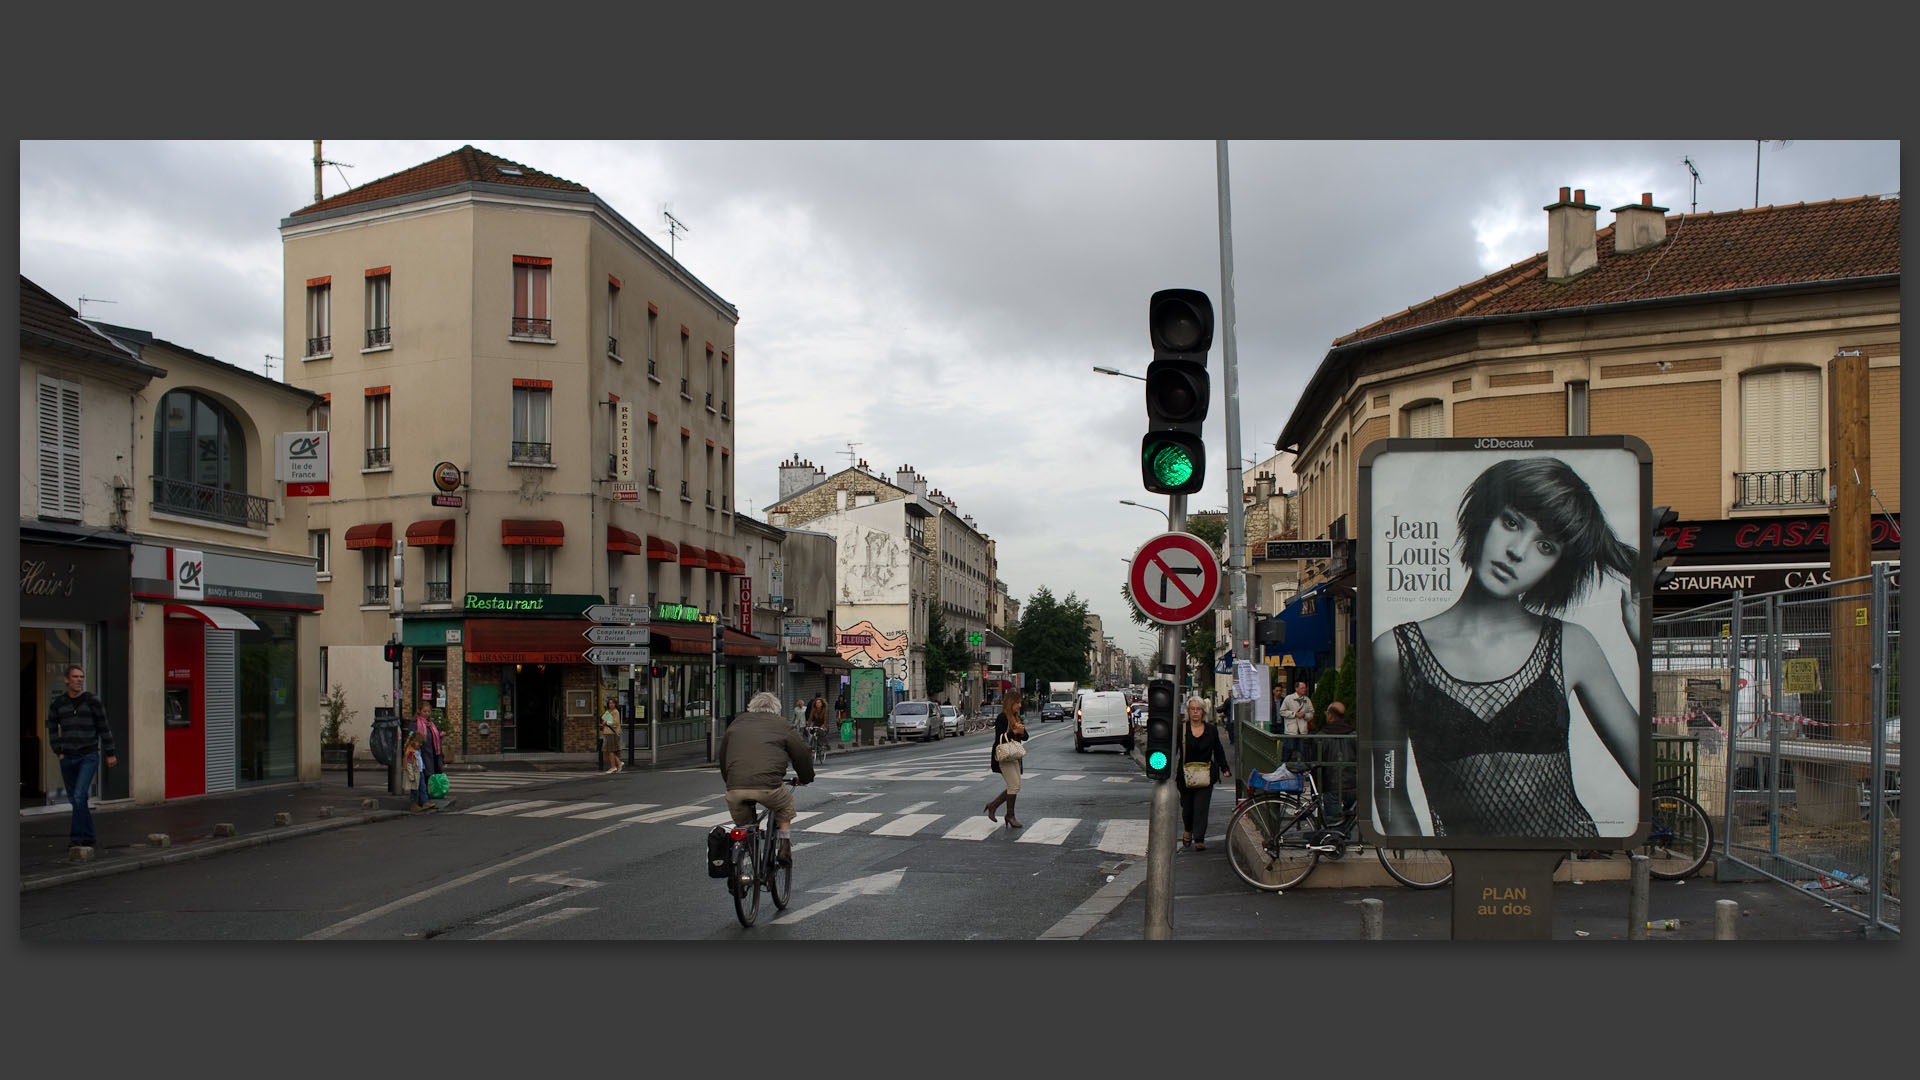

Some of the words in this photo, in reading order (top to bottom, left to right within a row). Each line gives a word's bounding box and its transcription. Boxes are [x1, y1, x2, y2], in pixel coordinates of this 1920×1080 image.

[621, 407, 629, 476] RESTAURANT
[1474, 438, 1534, 449] JCDecaux
[1385, 515, 1440, 540] Jean
[1657, 526, 1703, 550] TE
[1386, 540, 1450, 566] Louis
[1386, 566, 1453, 592] David
[1660, 575, 1756, 591] STAURANT
[465, 595, 544, 610] Restaurant
[842, 635, 870, 645] FLEURS
[1482, 887, 1527, 900] PLAN
[1477, 904, 1497, 915] au
[1502, 901, 1532, 916] dos
